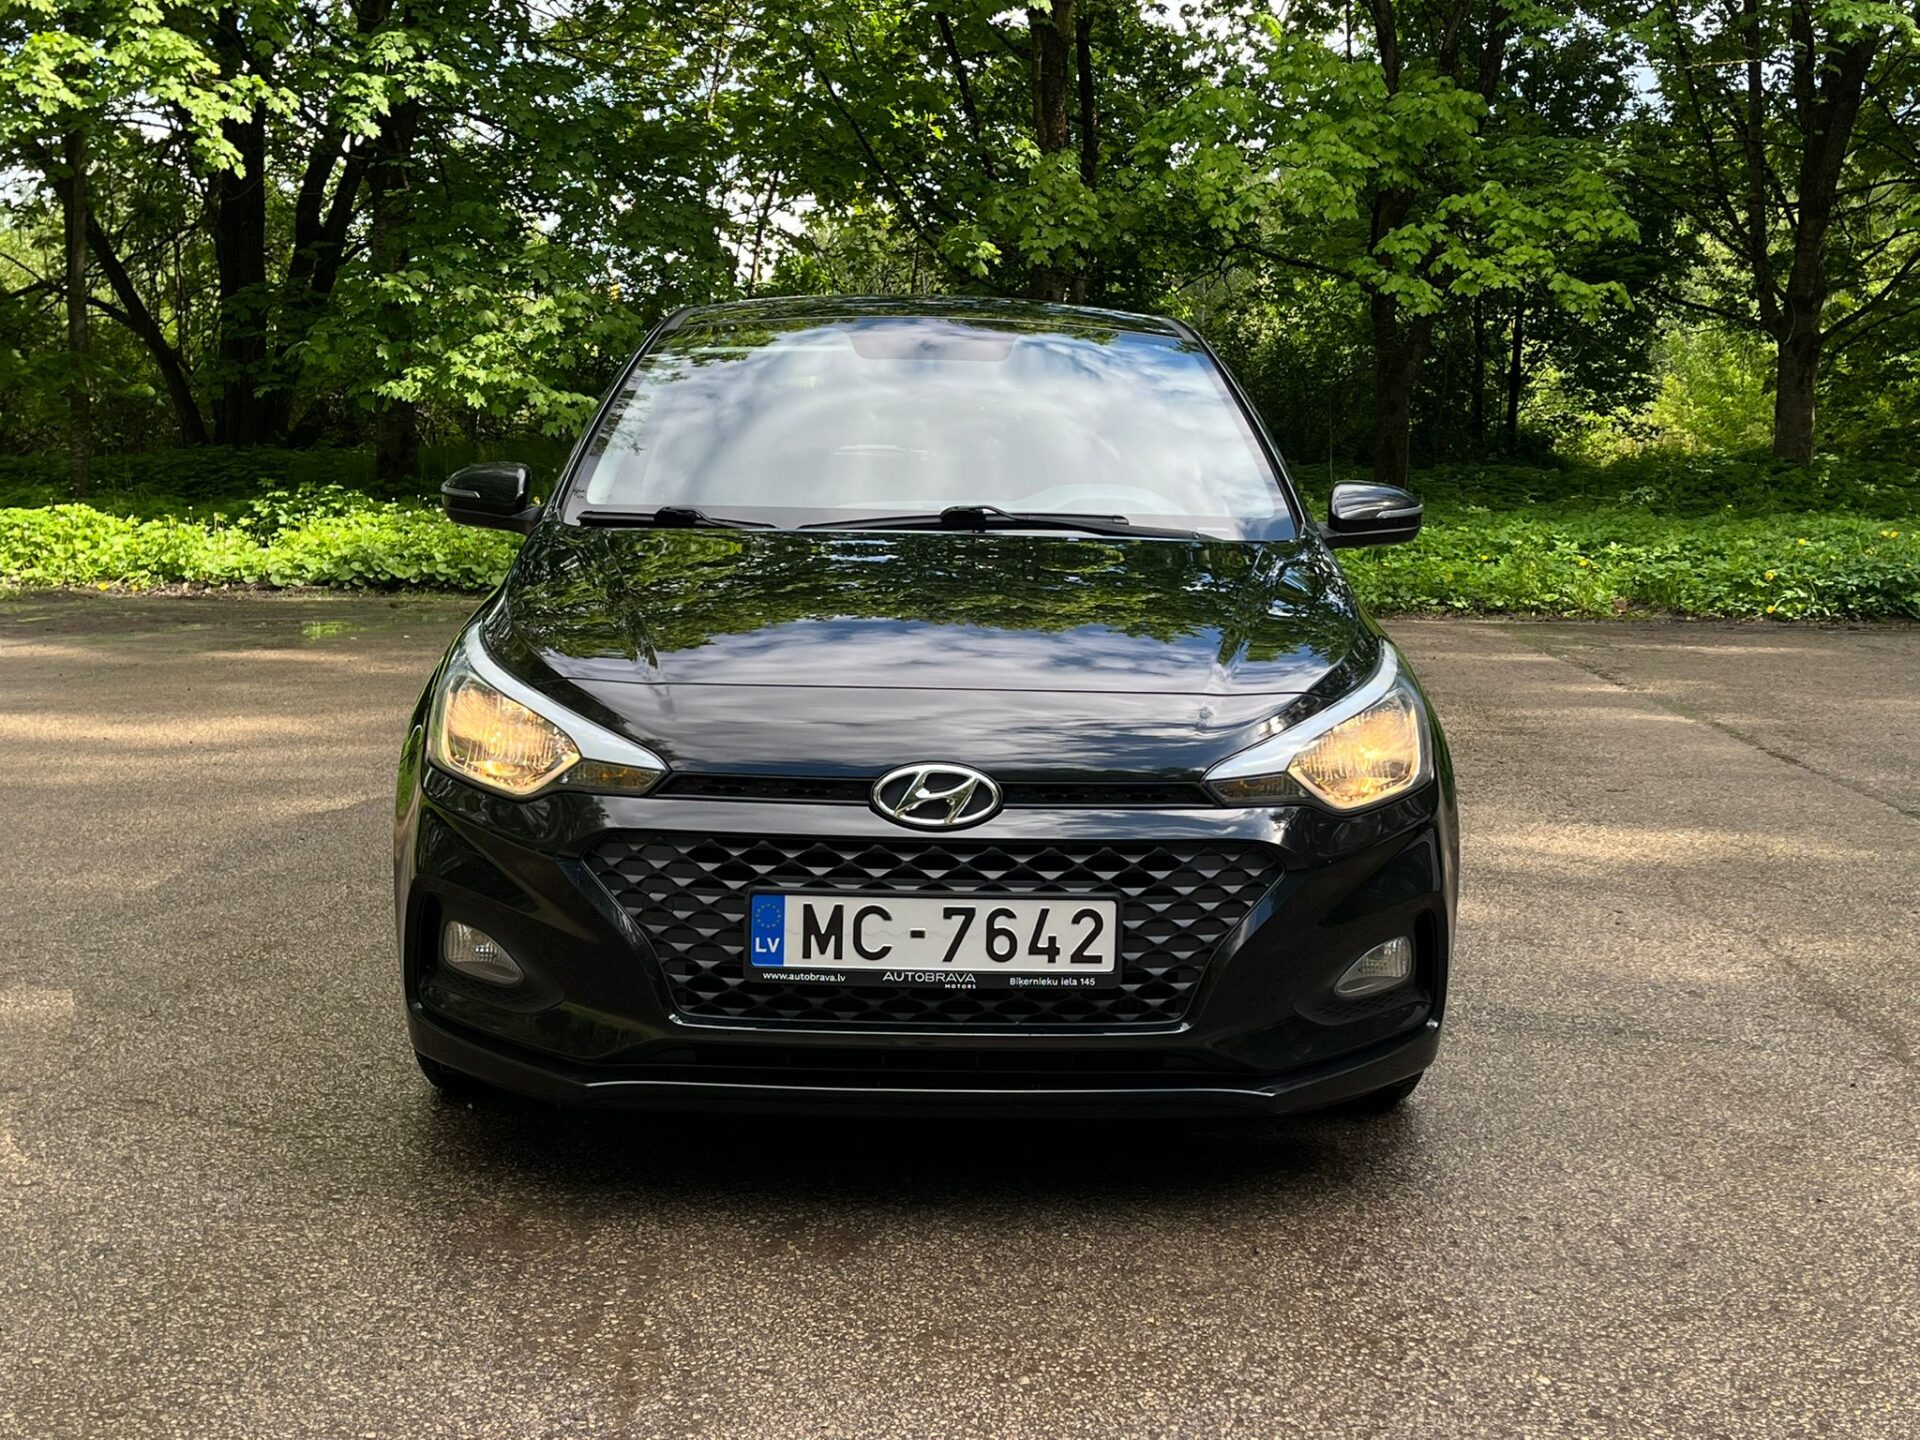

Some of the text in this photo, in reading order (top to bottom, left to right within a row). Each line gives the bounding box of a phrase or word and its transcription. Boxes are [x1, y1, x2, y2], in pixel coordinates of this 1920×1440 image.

[755, 937, 780, 953] LV
[763, 972, 846, 982] www.autobrava.lv
[883, 972, 976, 983] AUTOBRAVA
[1061, 977, 1077, 986] iela
[1080, 977, 1096, 986] 145
